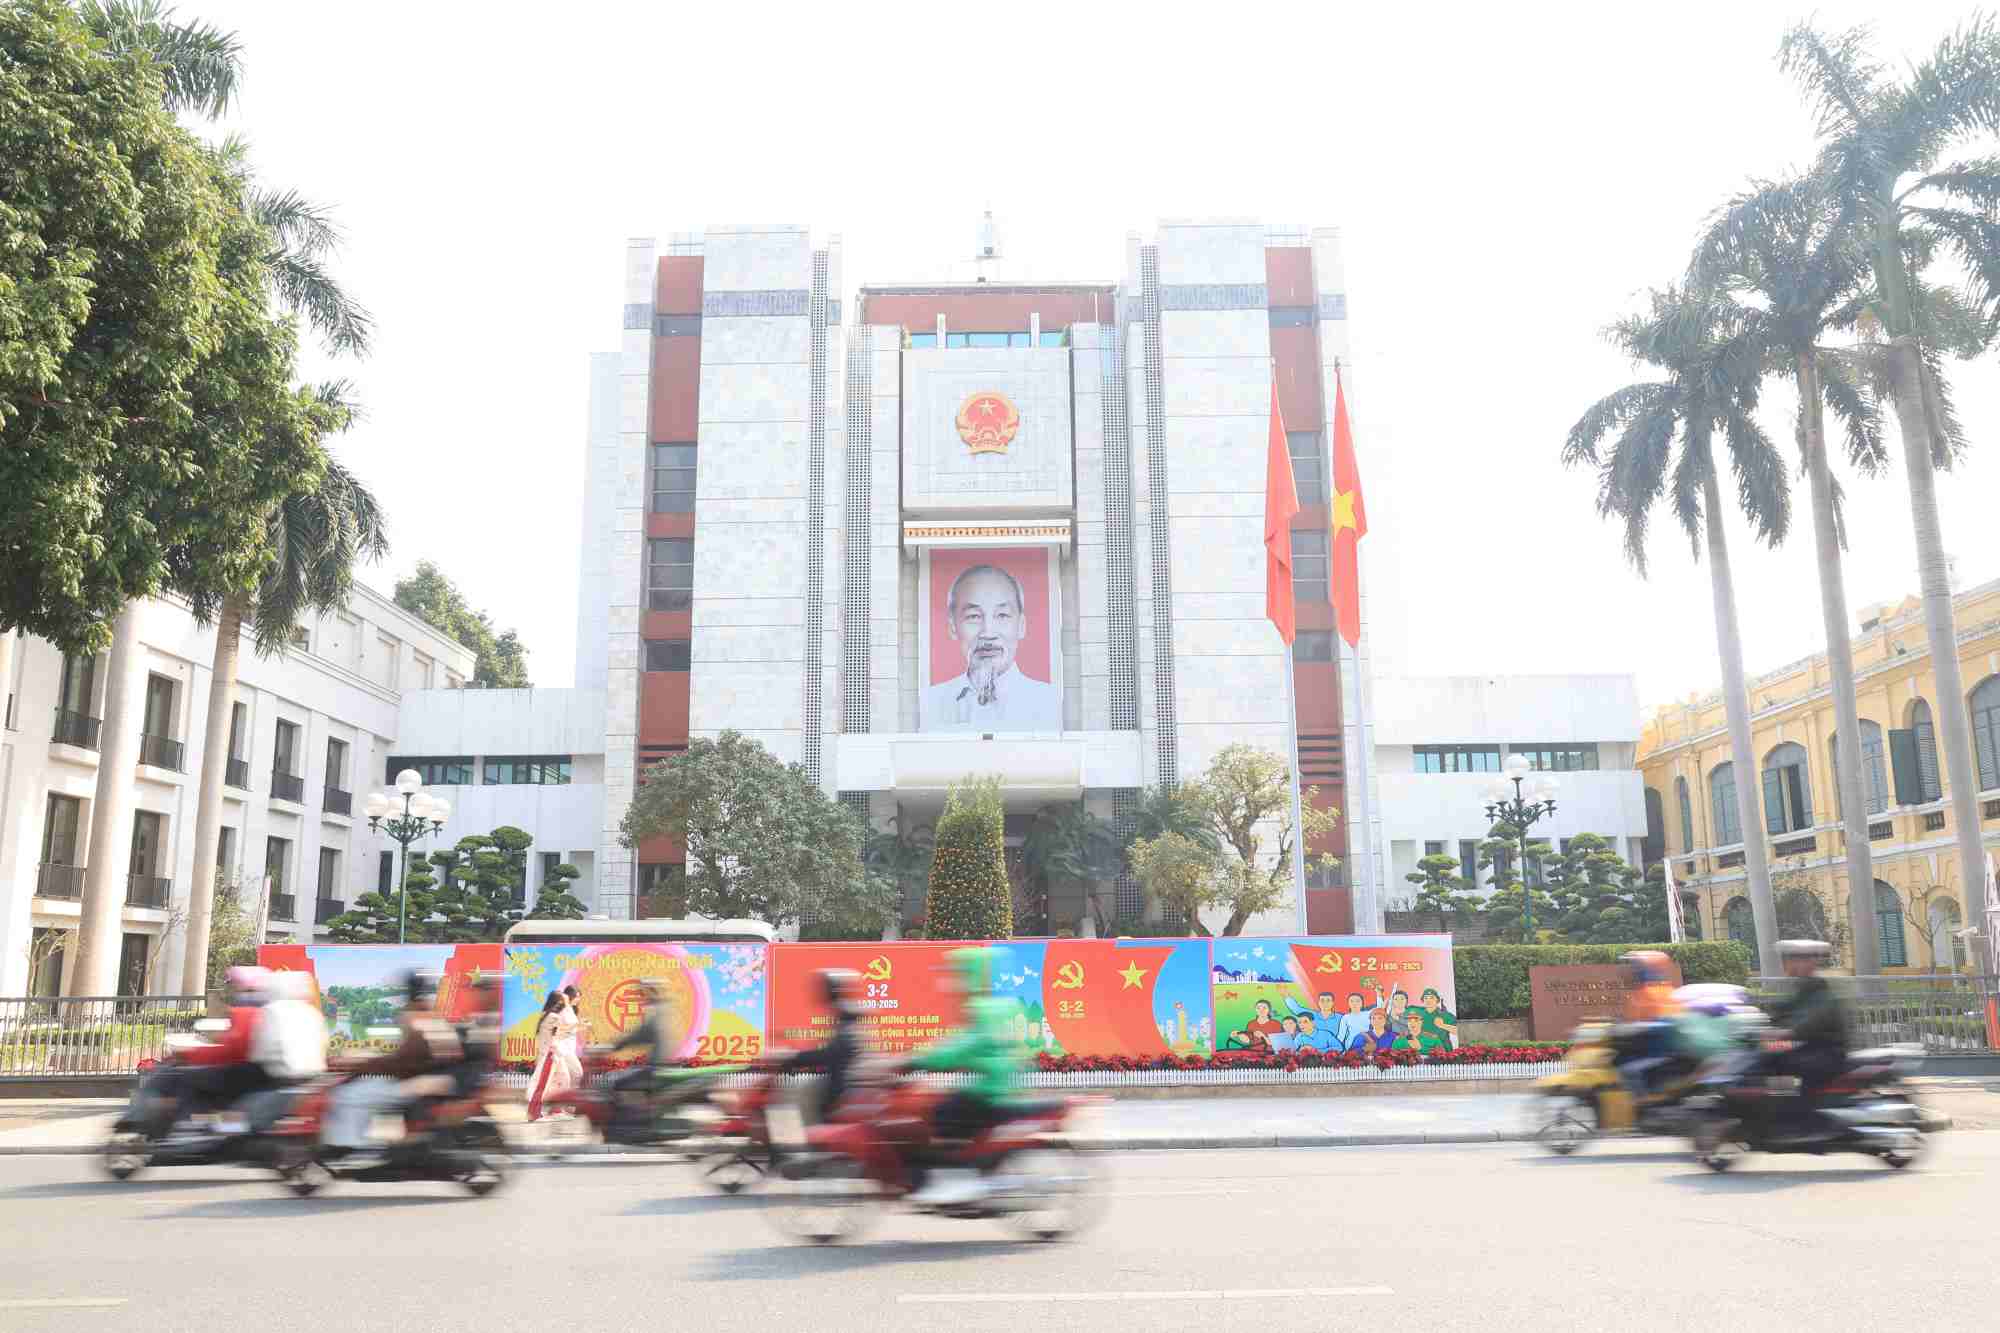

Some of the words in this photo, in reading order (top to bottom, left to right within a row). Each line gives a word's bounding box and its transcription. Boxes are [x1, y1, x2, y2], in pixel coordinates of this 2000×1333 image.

[1350, 957, 1377, 971] 3-2
[867, 983, 889, 997] 3-2
[1059, 1000, 1085, 1012] 3-2
[696, 1035, 760, 1057] 2025
